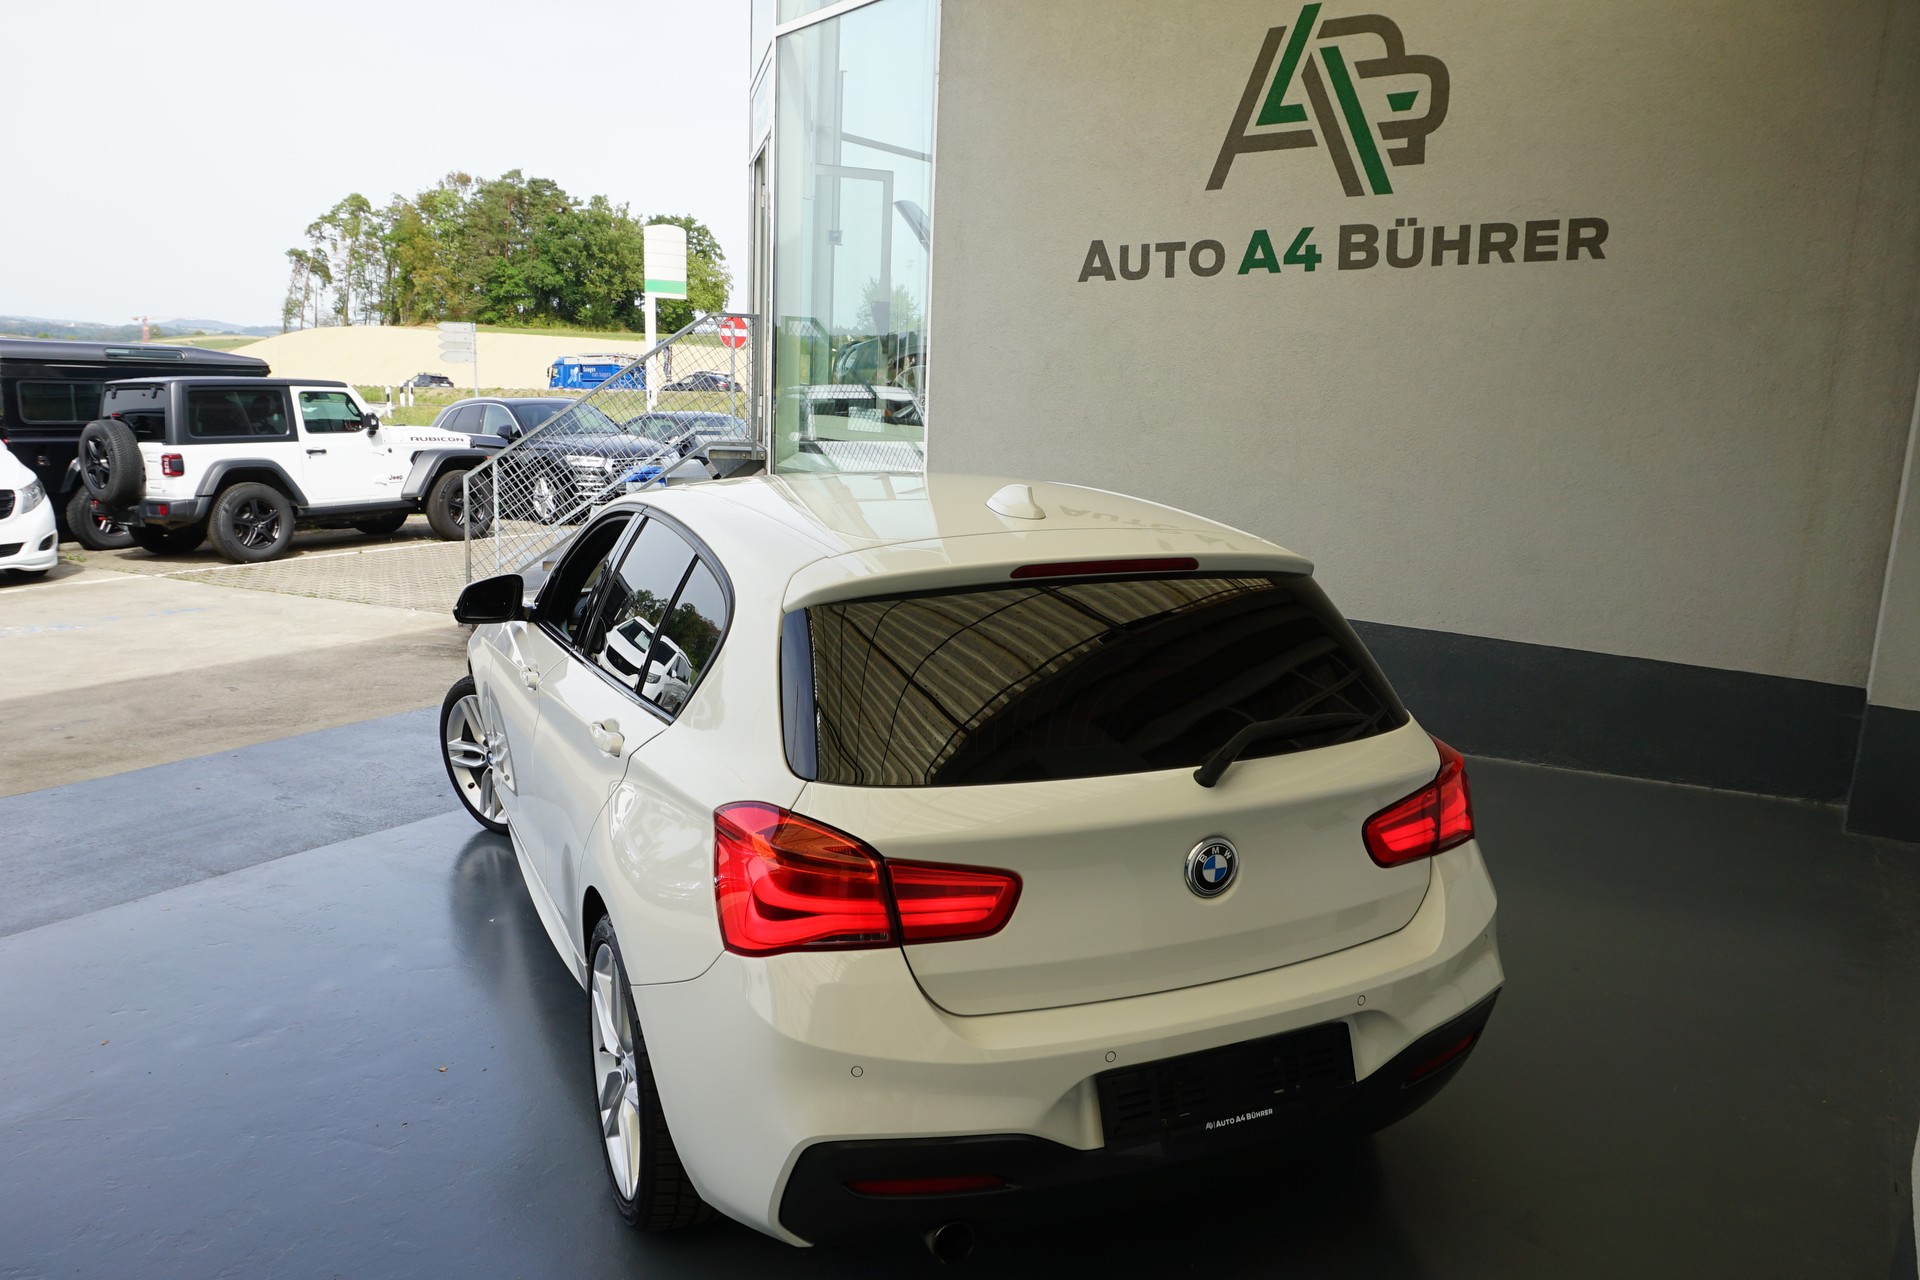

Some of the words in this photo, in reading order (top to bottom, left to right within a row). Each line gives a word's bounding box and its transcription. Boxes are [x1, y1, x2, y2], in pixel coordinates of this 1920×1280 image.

[1077, 239, 1226, 283] AUTO
[1237, 226, 1323, 276] A4
[1337, 217, 1610, 271] BÜHRER
[1216, 1118, 1235, 1128] AUTO
[1235, 1114, 1246, 1123] A4
[1246, 1108, 1273, 1120] BÜHRER
